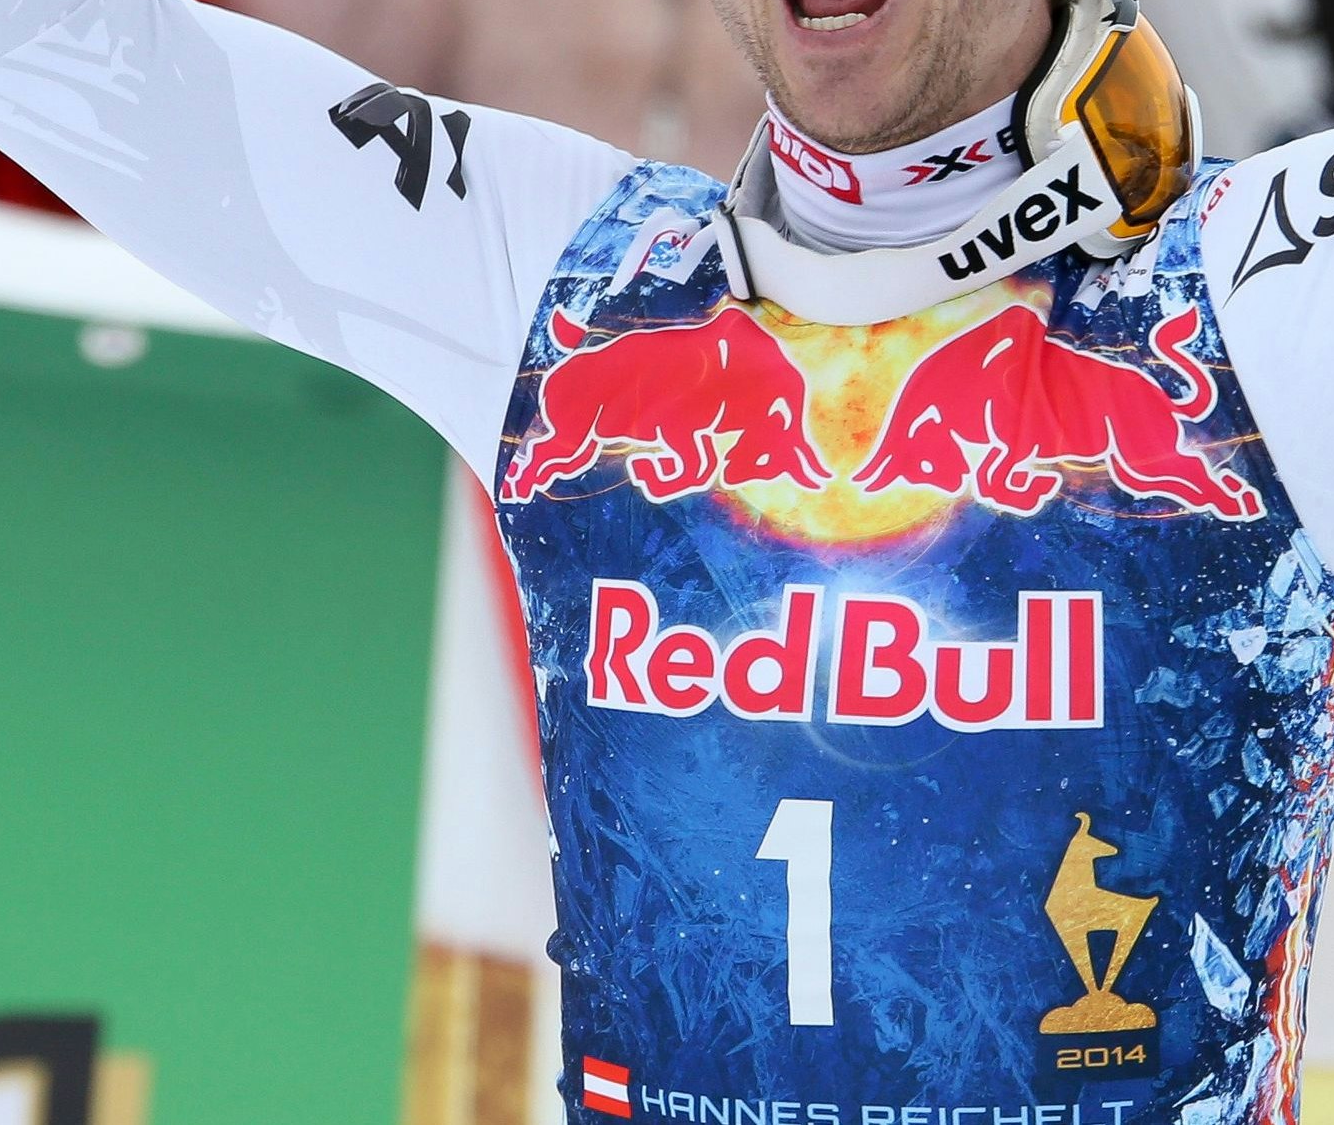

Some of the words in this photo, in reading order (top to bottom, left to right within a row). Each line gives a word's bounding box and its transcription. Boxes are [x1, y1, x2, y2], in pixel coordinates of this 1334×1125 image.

[937, 162, 1104, 282] uvex
[586, 579, 819, 722] Red
[831, 592, 1105, 728] Bull
[755, 798, 835, 1027] 1
[640, 1084, 841, 1125] HANNES
[1056, 1044, 1148, 1069] 2014
